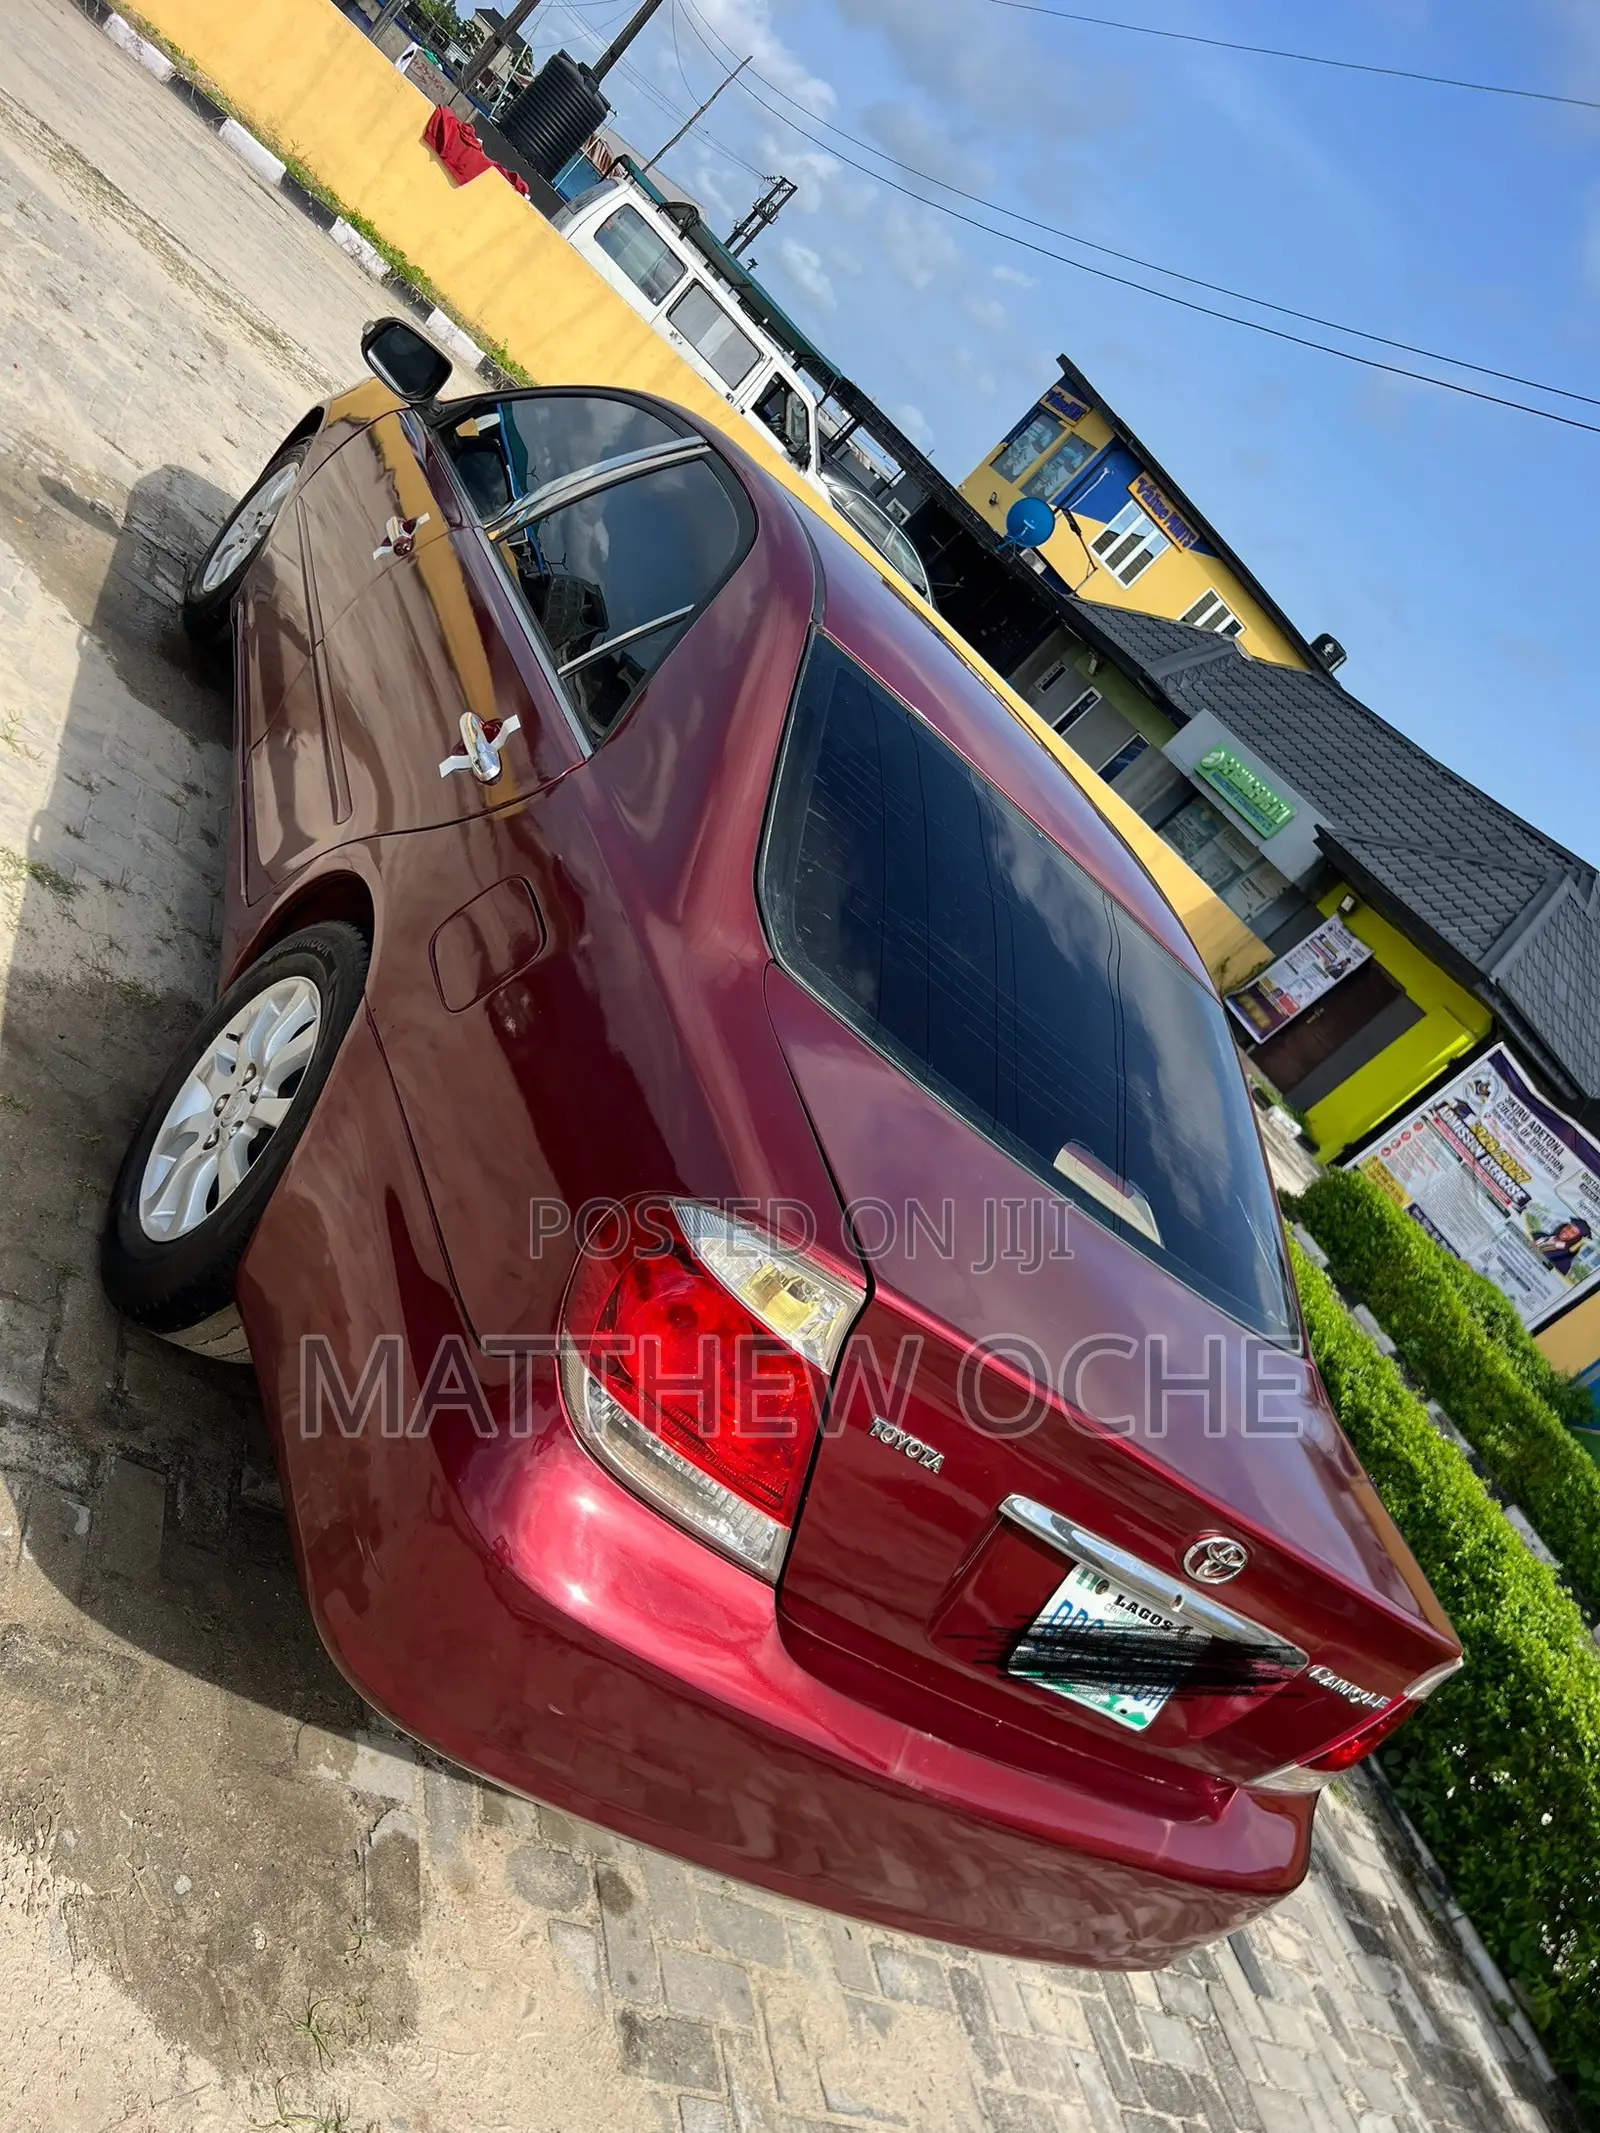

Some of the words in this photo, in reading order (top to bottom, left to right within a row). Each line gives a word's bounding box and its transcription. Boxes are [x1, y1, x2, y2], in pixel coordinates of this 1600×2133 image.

[1438, 1105, 1486, 1159] ADMISSION
[1480, 1155, 1527, 1203] EXERCISE
[1528, 1119, 1565, 1156] ADETONA
[869, 1414, 945, 1474] TOYOTA
[1114, 1594, 1174, 1630] LAGOS
